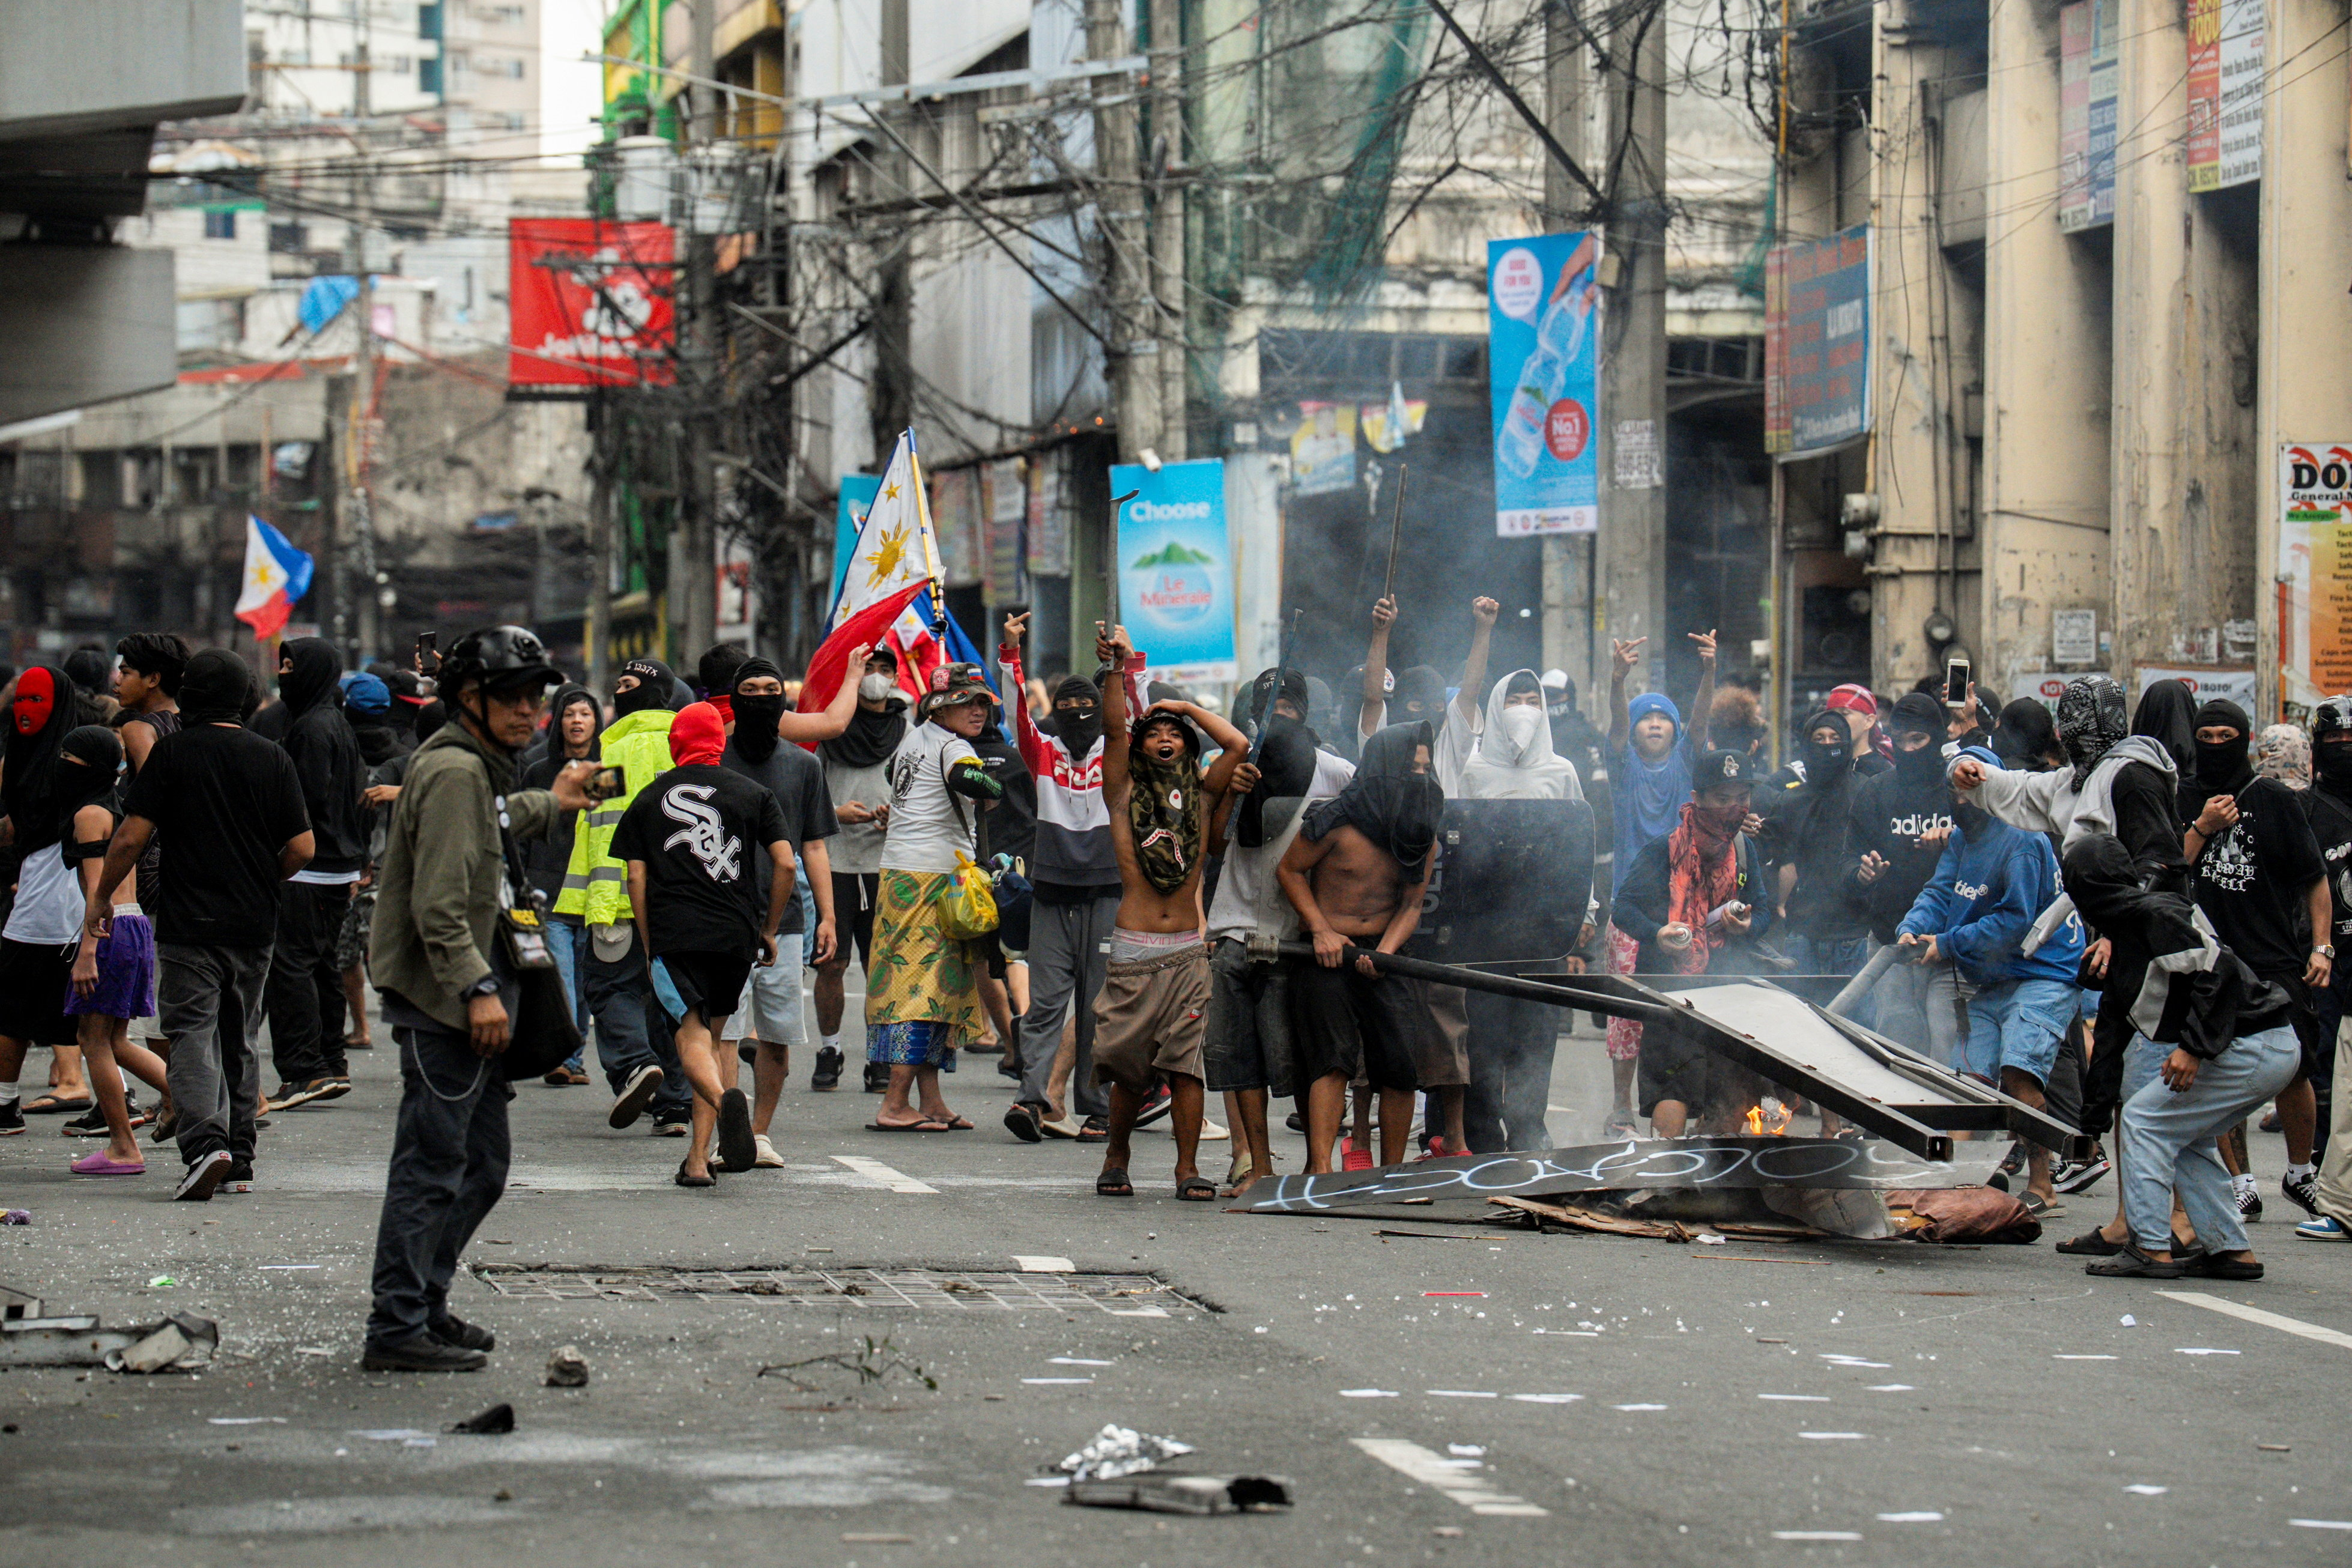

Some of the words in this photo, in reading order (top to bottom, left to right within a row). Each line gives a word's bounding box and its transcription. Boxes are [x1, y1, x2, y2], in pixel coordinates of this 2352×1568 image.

[2292, 463, 2352, 489] DO
[2291, 491, 2343, 501] General
[1129, 500, 1211, 522] Choose
[1163, 575, 1186, 592] Le
[2044, 683, 2063, 695] 101
[1053, 759, 1103, 786] FILA
[1891, 813, 1956, 835] adida
